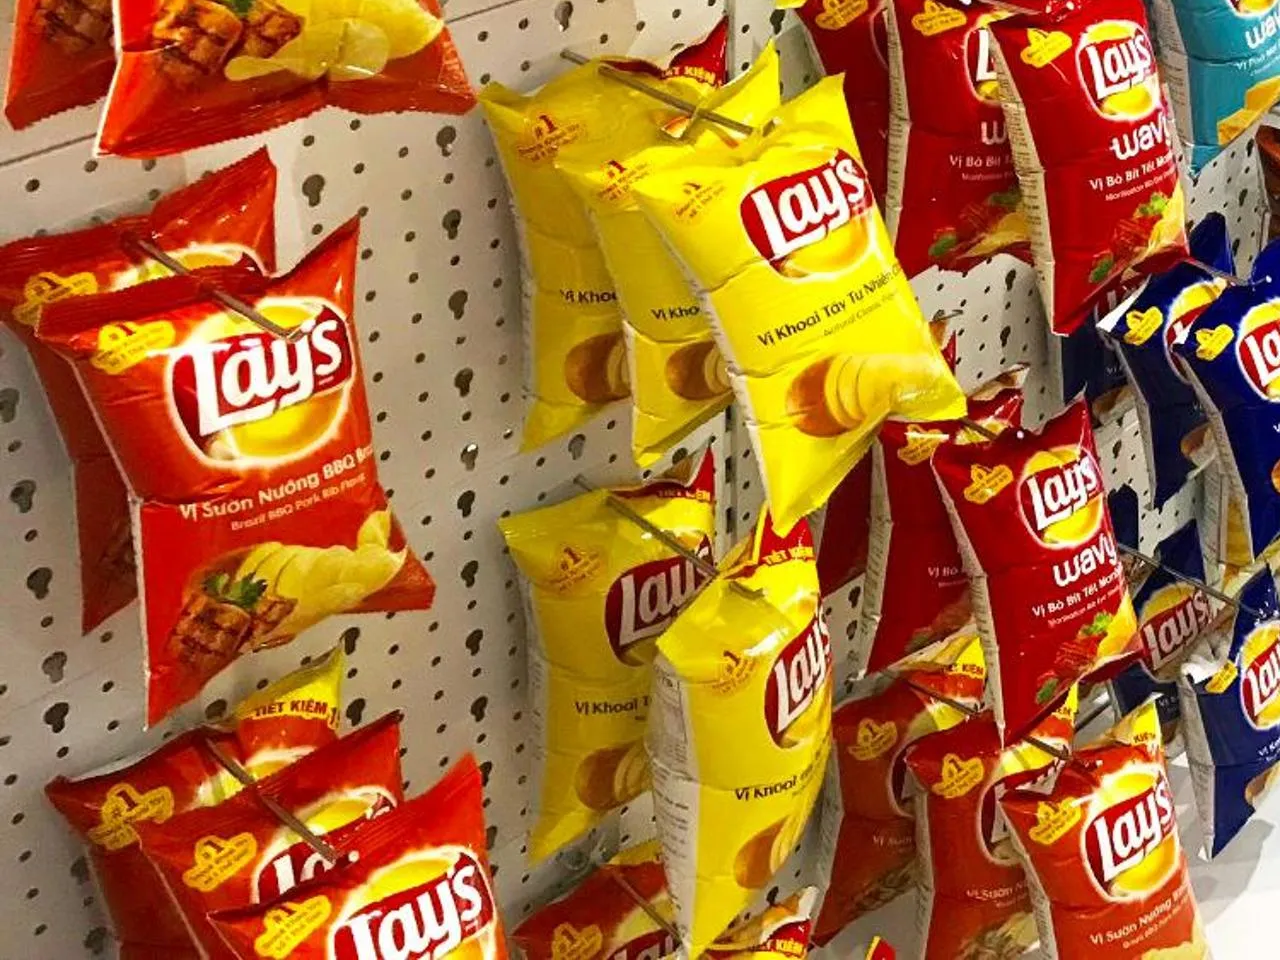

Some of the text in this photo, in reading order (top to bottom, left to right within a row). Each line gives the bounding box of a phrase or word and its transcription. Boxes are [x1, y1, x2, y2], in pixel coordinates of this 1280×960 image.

[1085, 33, 1151, 100] Lay's
[751, 148, 866, 260] Lay's
[191, 316, 344, 437] Lay's
[1027, 454, 1099, 531] Lay's
[775, 614, 830, 734] Lay's
[1143, 590, 1211, 671] Lay's
[1095, 785, 1173, 882] Lay's
